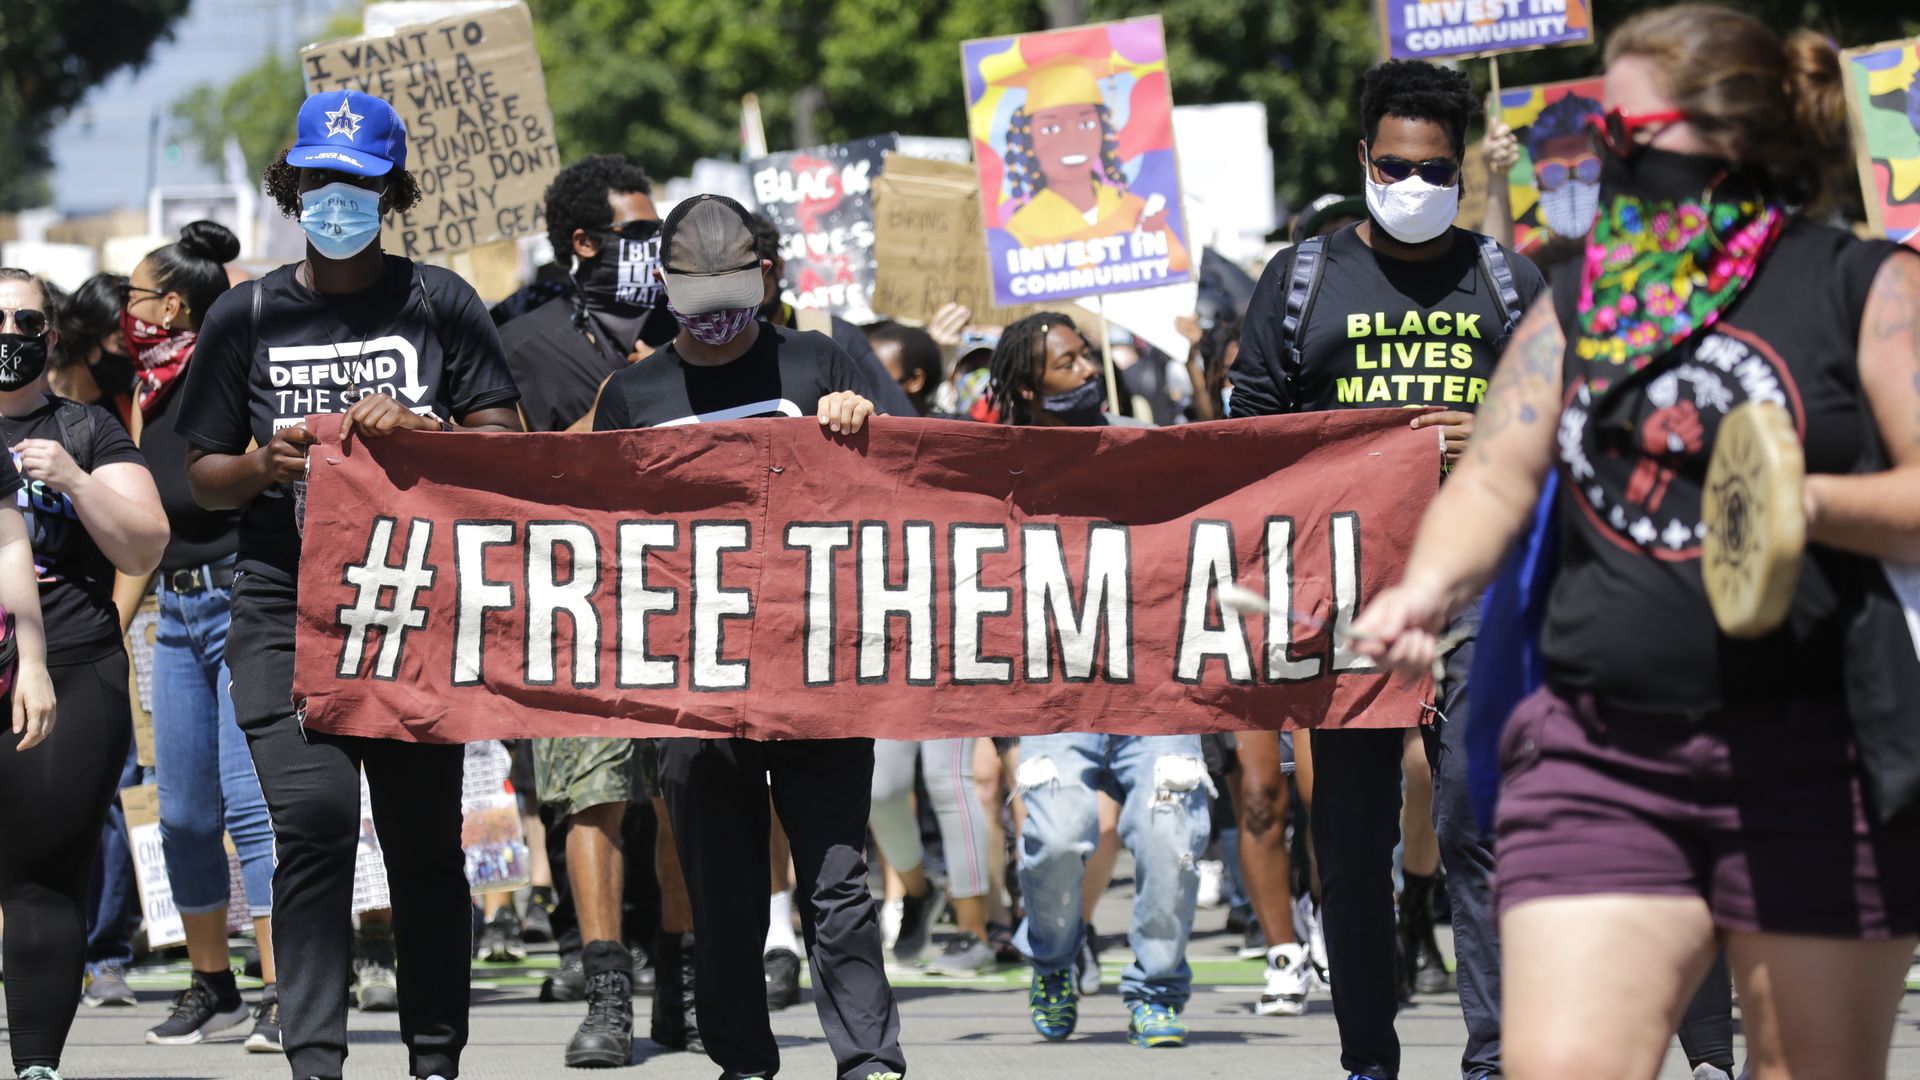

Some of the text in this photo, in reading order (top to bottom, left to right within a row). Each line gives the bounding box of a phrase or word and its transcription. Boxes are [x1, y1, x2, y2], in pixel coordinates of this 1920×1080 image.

[1403, 0, 1566, 29] INVEST IN
[1405, 14, 1568, 52] COMMUNITY
[307, 21, 483, 80] I WANT TO
[402, 59, 439, 88] IN
[456, 52, 475, 78] A
[408, 71, 498, 111] WHERE
[456, 94, 520, 133] ARE
[416, 124, 518, 166] FUNDED
[523, 116, 545, 142] &
[411, 160, 475, 195] OPS
[754, 158, 871, 204] BLACK
[439, 186, 497, 220] ANY
[402, 216, 476, 257] RIOT
[1007, 235, 1126, 274] INVEST
[1130, 230, 1168, 259] IN
[1009, 258, 1170, 297] COMMUNITY
[1347, 310, 1482, 339] BLACK
[269, 356, 397, 388] DEFUND
[1356, 342, 1473, 370] LIVES
[276, 388, 332, 414] THE
[1336, 375, 1489, 404] MATTER
[336, 515, 754, 692] #FREE
[783, 519, 1134, 688] THEM
[1174, 510, 1381, 686] ALL
